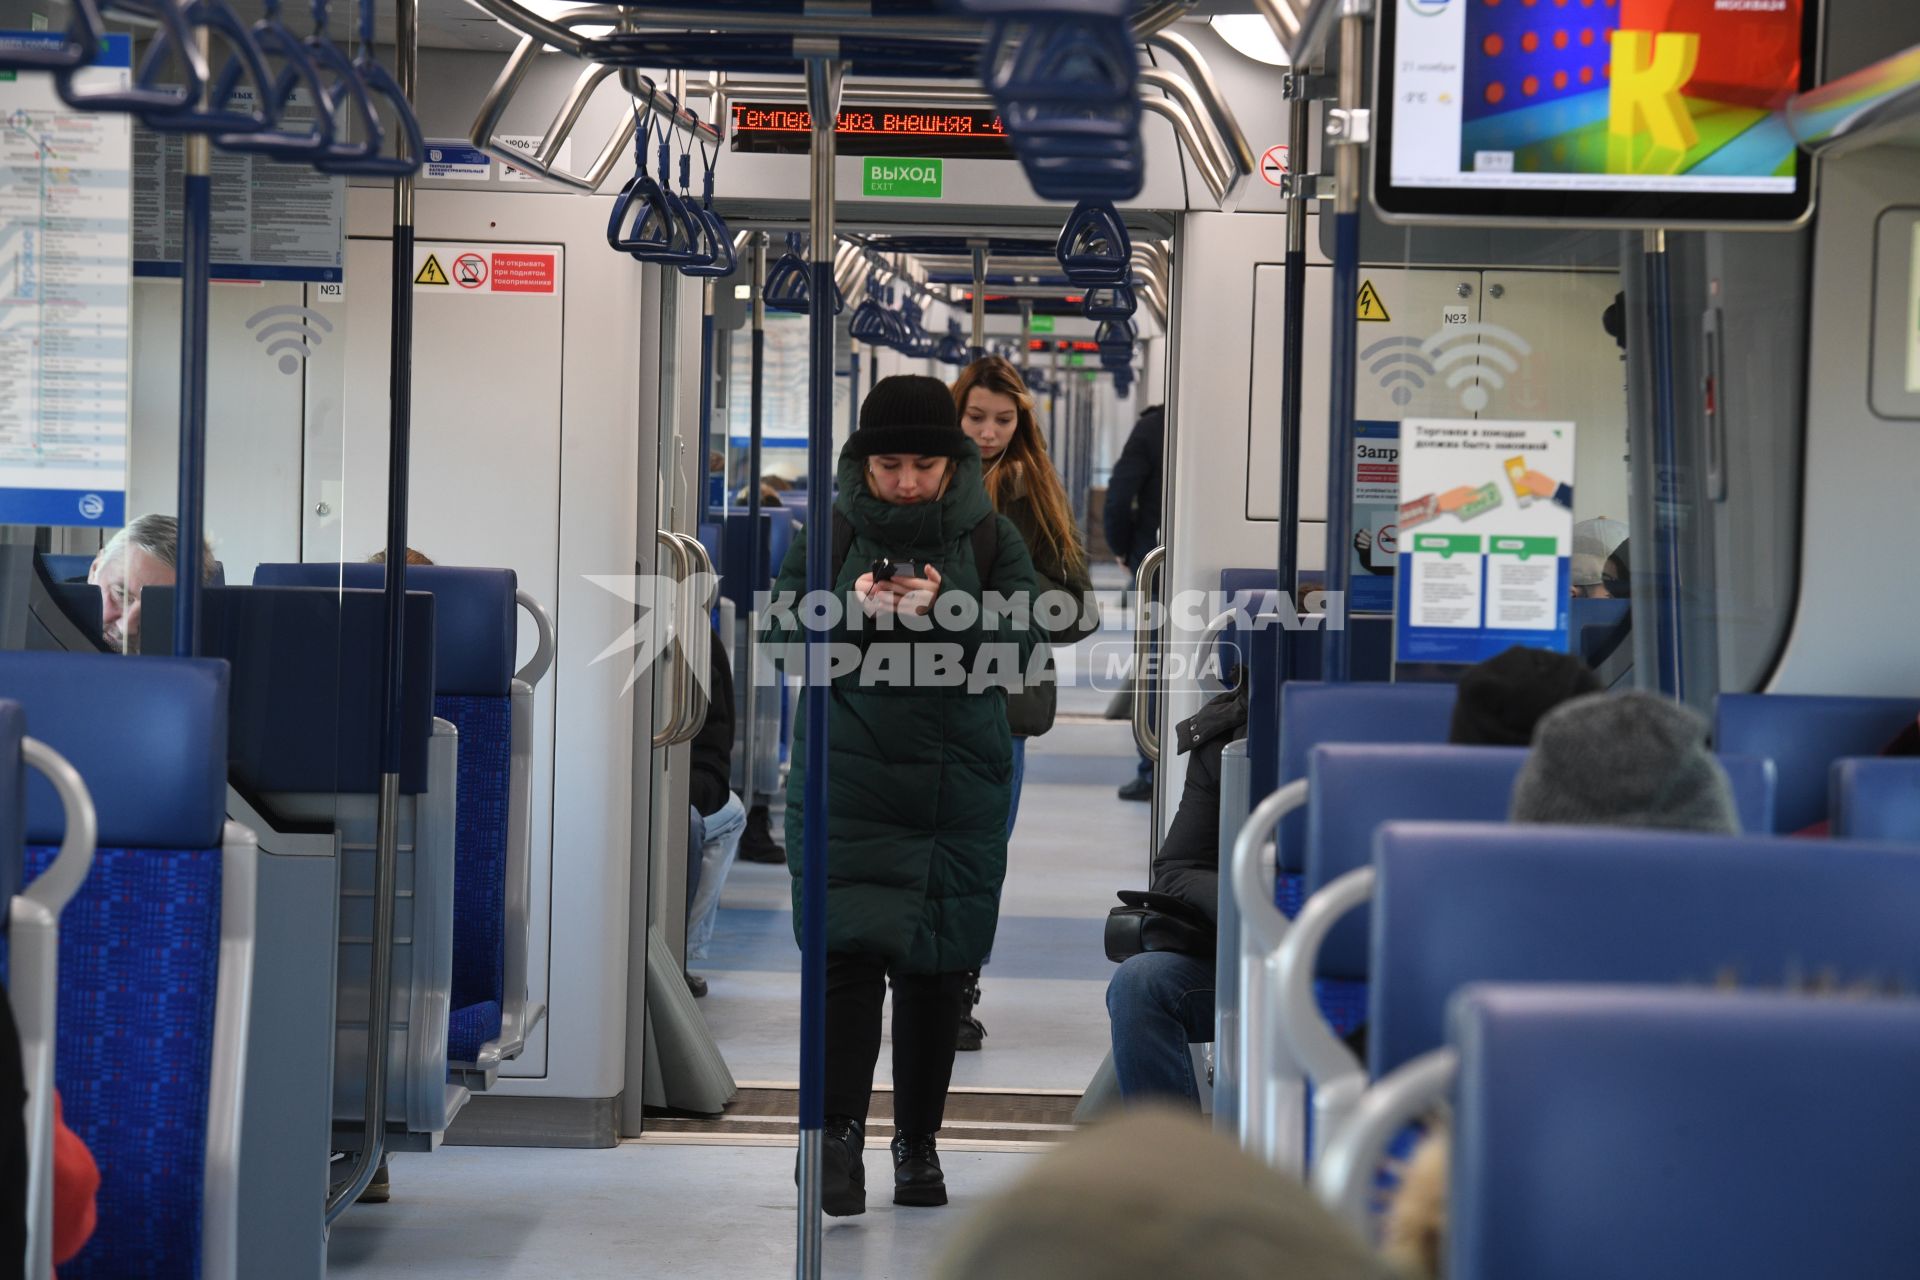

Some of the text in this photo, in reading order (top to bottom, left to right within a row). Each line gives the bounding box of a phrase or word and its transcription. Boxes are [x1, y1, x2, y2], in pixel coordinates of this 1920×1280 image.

[732, 106, 874, 131] Темперура
[883, 114, 972, 133] внешняя
[871, 166, 937, 184] ВЫХОД
[871, 182, 894, 191] EXIT
[506, 260, 546, 268] открывать
[494, 278, 552, 286] токоприемнике
[320, 284, 342, 295] №1
[1444, 313, 1468, 324] №3
[1416, 426, 1468, 437] Торговля
[1415, 440, 1459, 450] должна
[1462, 440, 1490, 450] быть
